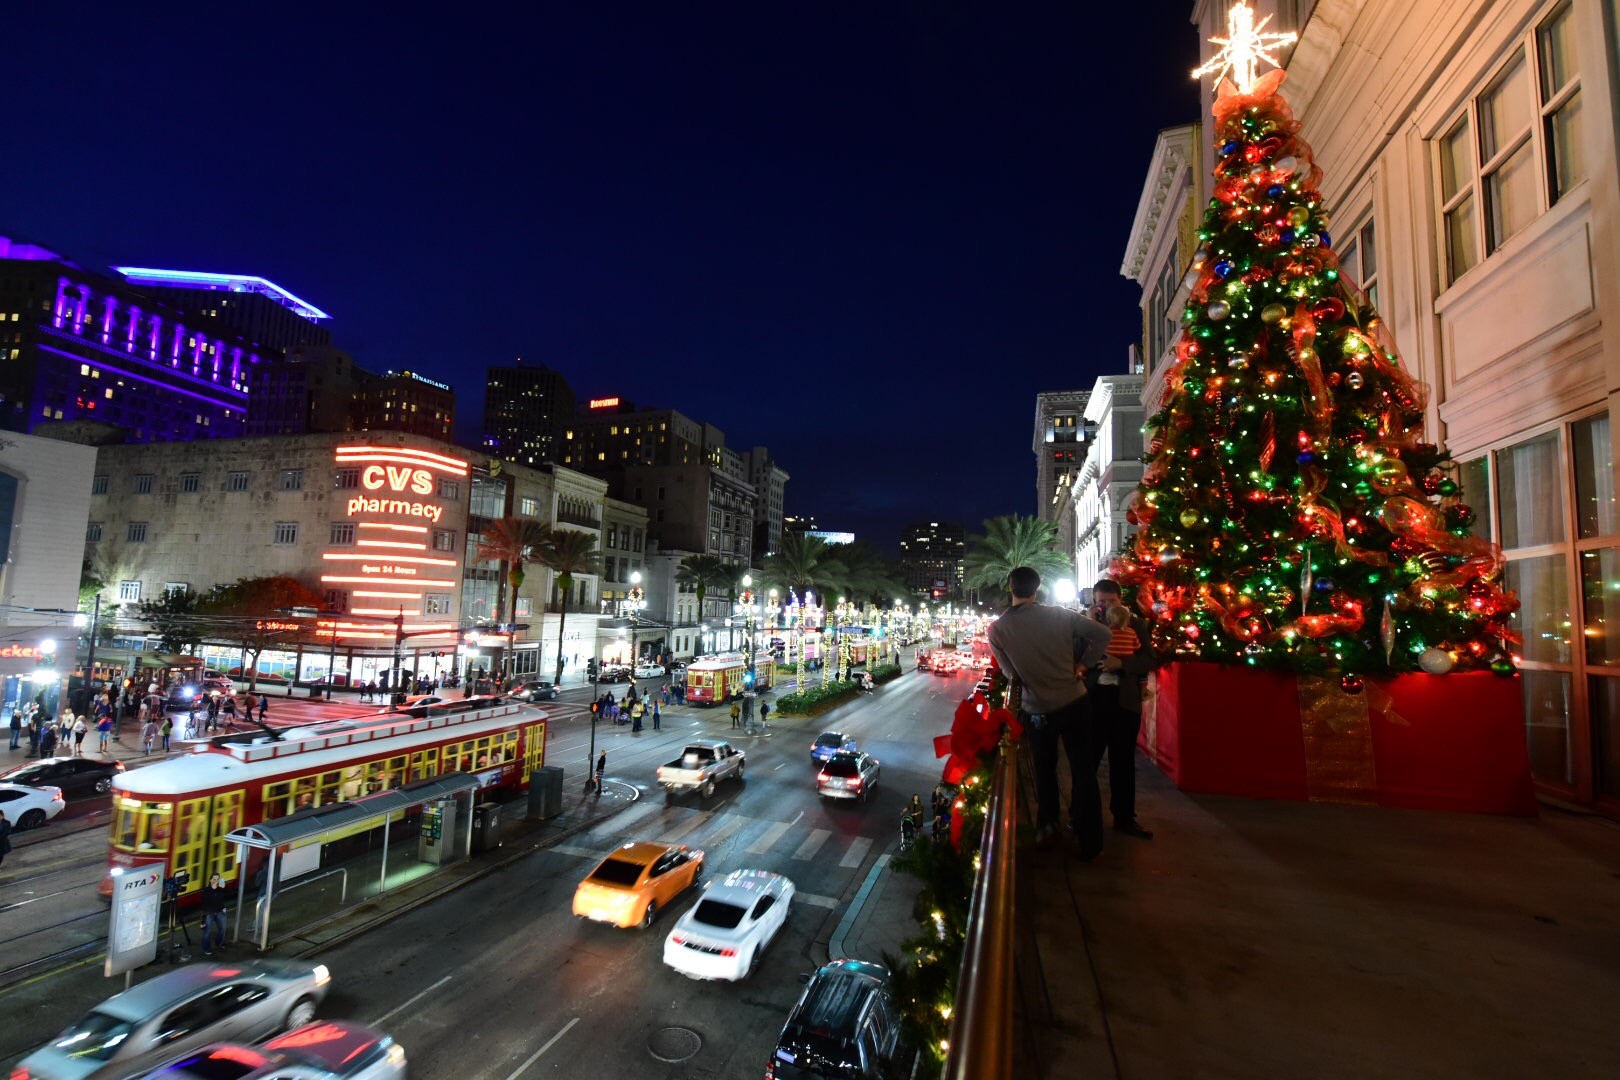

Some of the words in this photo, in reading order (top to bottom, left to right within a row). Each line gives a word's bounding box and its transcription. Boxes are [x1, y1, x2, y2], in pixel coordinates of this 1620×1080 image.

[362, 465, 433, 495] CVS
[347, 495, 443, 522] pharmacy
[124, 878, 147, 890] RTA
